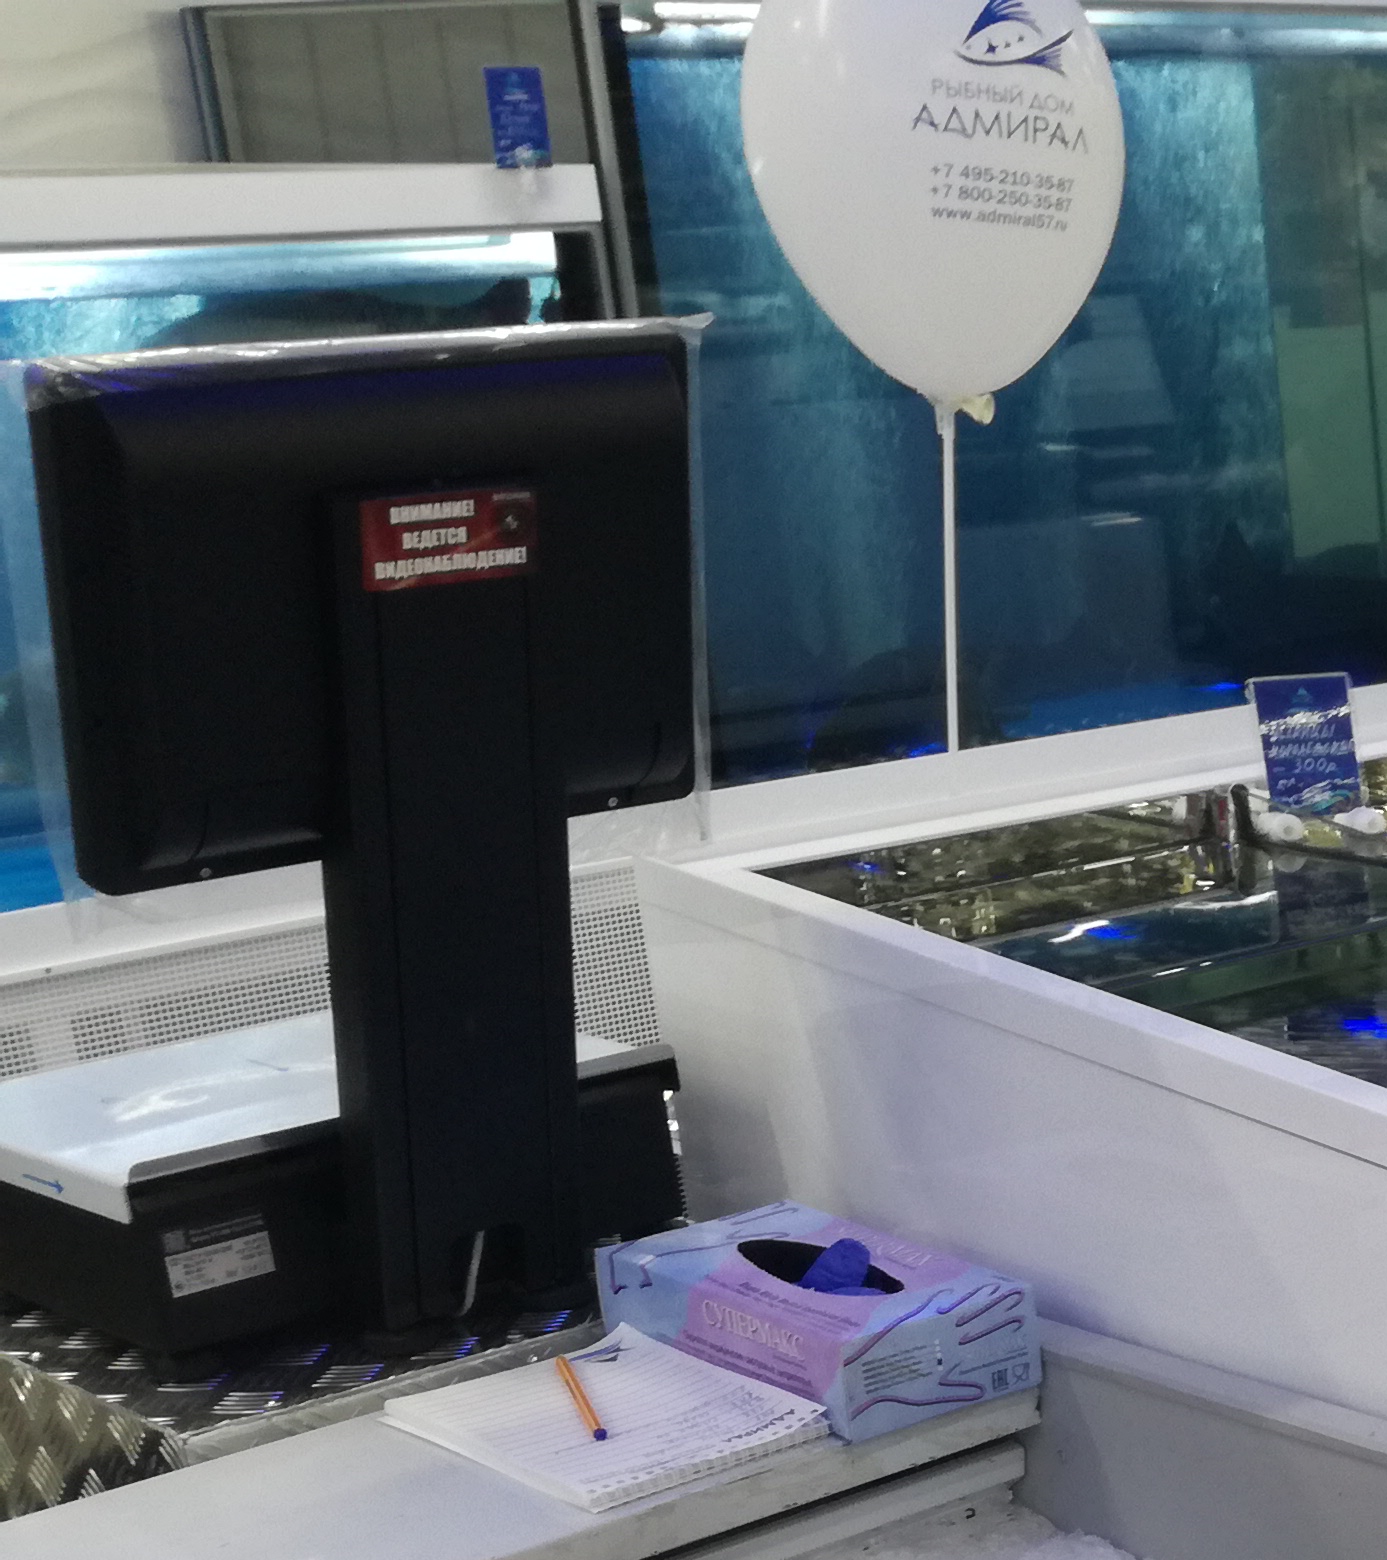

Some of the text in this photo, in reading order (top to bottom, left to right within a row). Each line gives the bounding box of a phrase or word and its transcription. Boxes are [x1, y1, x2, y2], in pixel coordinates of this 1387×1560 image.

[931, 78, 1075, 115] РЫБНЫЙ ДОМ
[911, 102, 1090, 155] АДМИРАЛ
[389, 499, 475, 525] ВНИМАНИЕ!
[402, 526, 468, 551] ВЕДЕТСЯ
[374, 546, 527, 580] ВИДЕОНАБЛЮДЕНИЕ!
